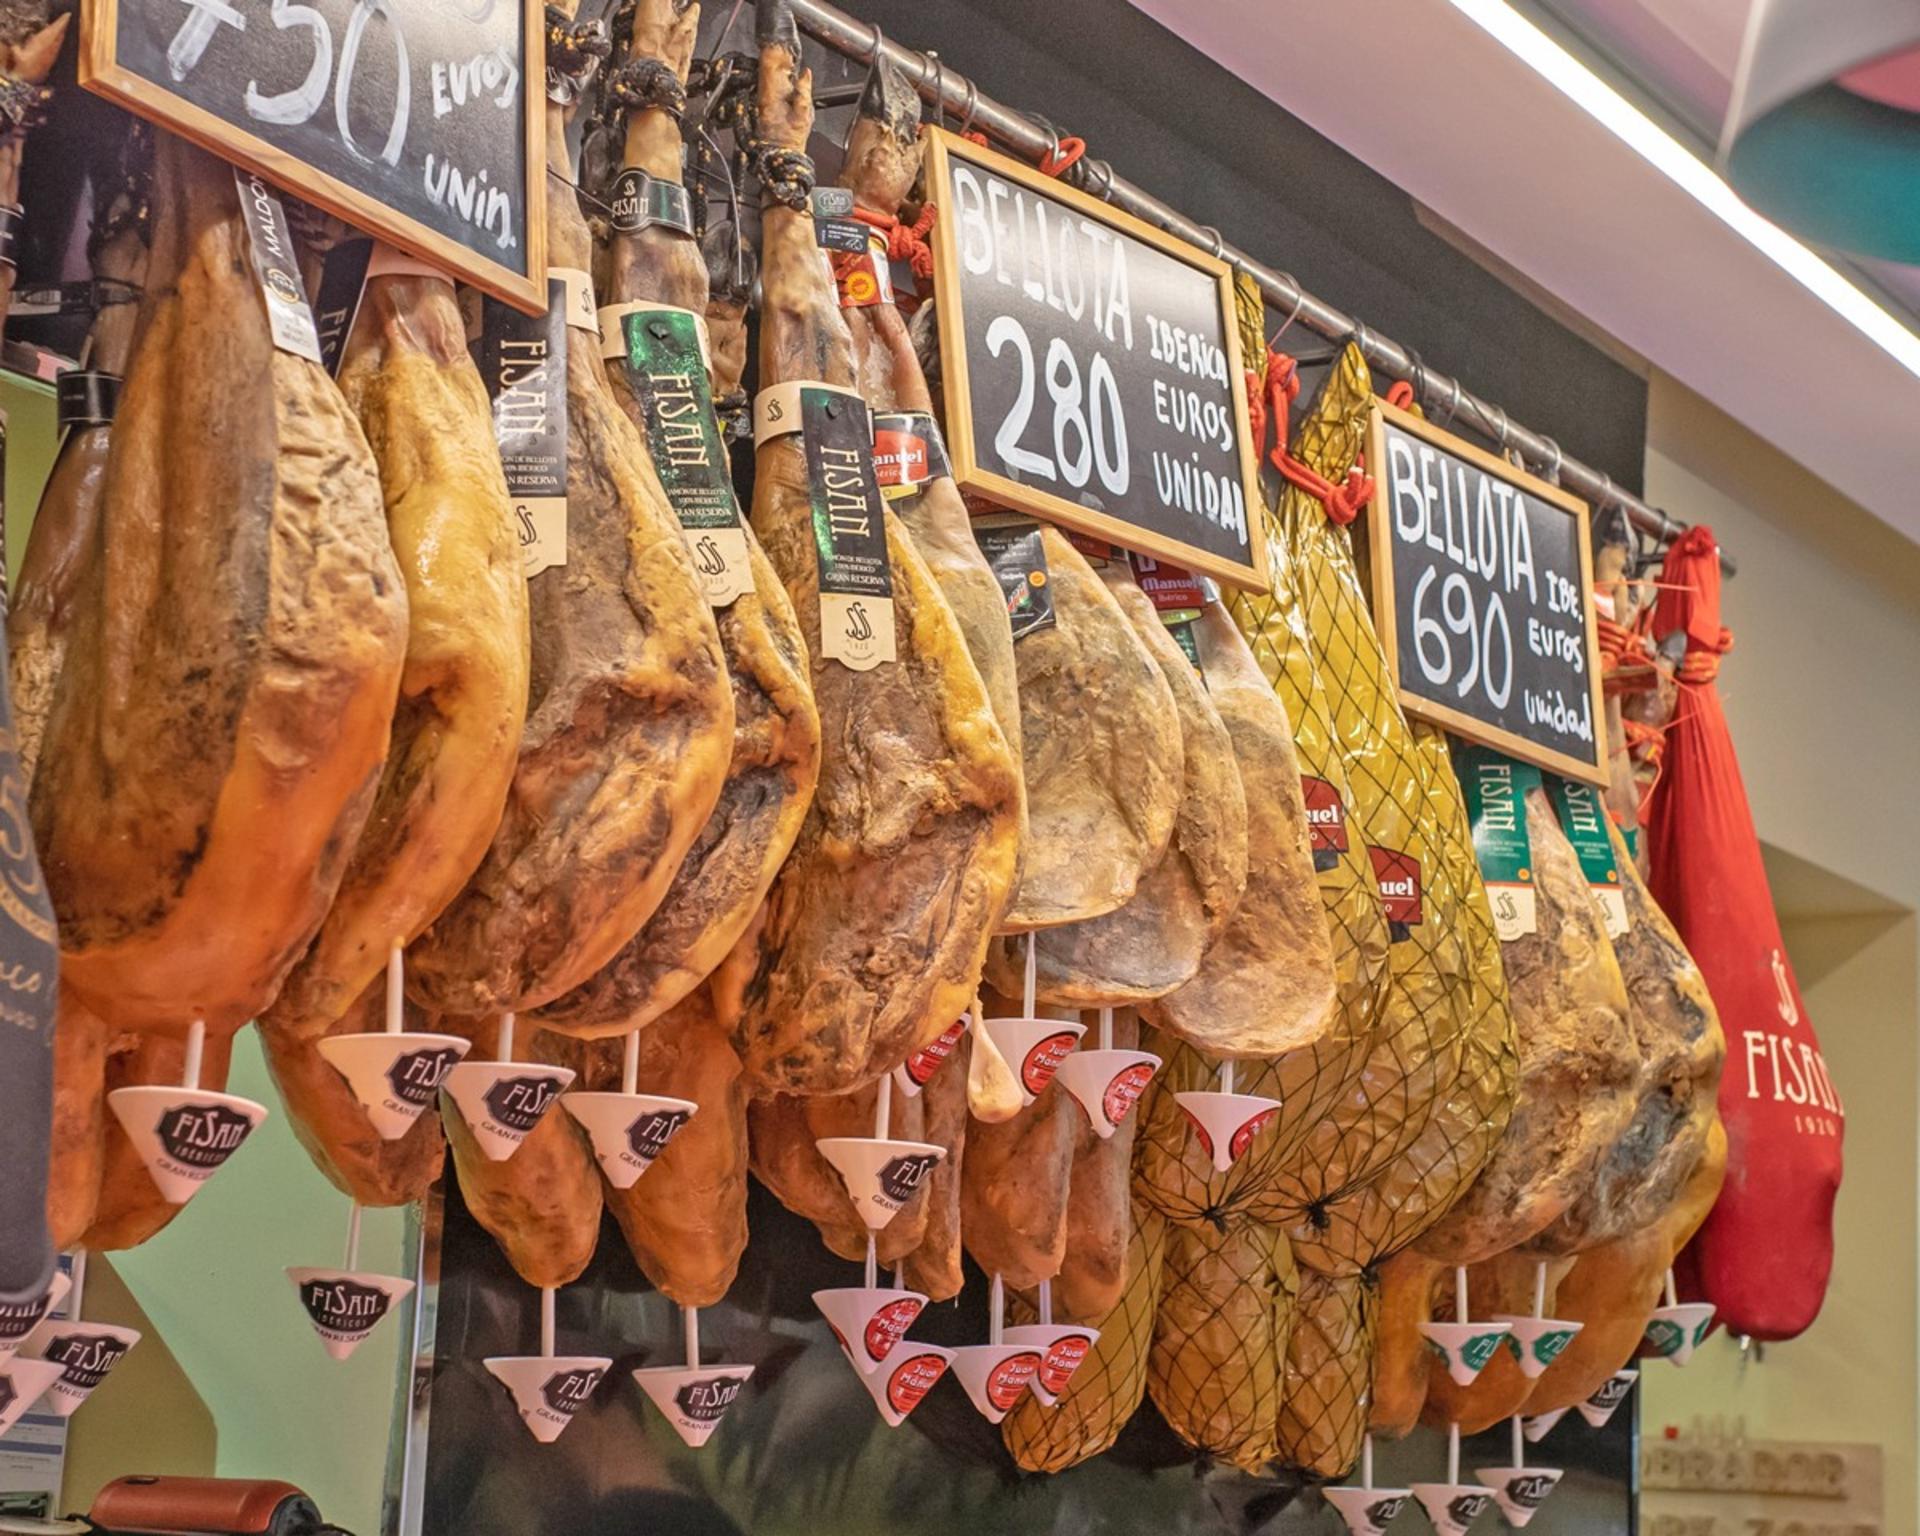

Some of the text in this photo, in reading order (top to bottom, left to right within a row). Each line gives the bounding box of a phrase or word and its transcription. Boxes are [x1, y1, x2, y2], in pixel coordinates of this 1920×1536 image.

[953, 167, 1134, 350] BELLOTA
[499, 339, 547, 435] FISAN
[649, 372, 711, 468] FISAN
[985, 315, 1129, 495] 280
[1153, 379, 1233, 452] EUROS
[820, 445, 870, 541] FISAN
[1389, 437, 1537, 606] BELLOTA
[825, 572, 886, 586] GRAN RESERVA
[1413, 565, 1513, 710] 690
[1478, 764, 1516, 832] FISAN
[1562, 780, 1600, 833] SAN
[171, 1111, 246, 1148] FISAN
[312, 1285, 378, 1315] FISAN
